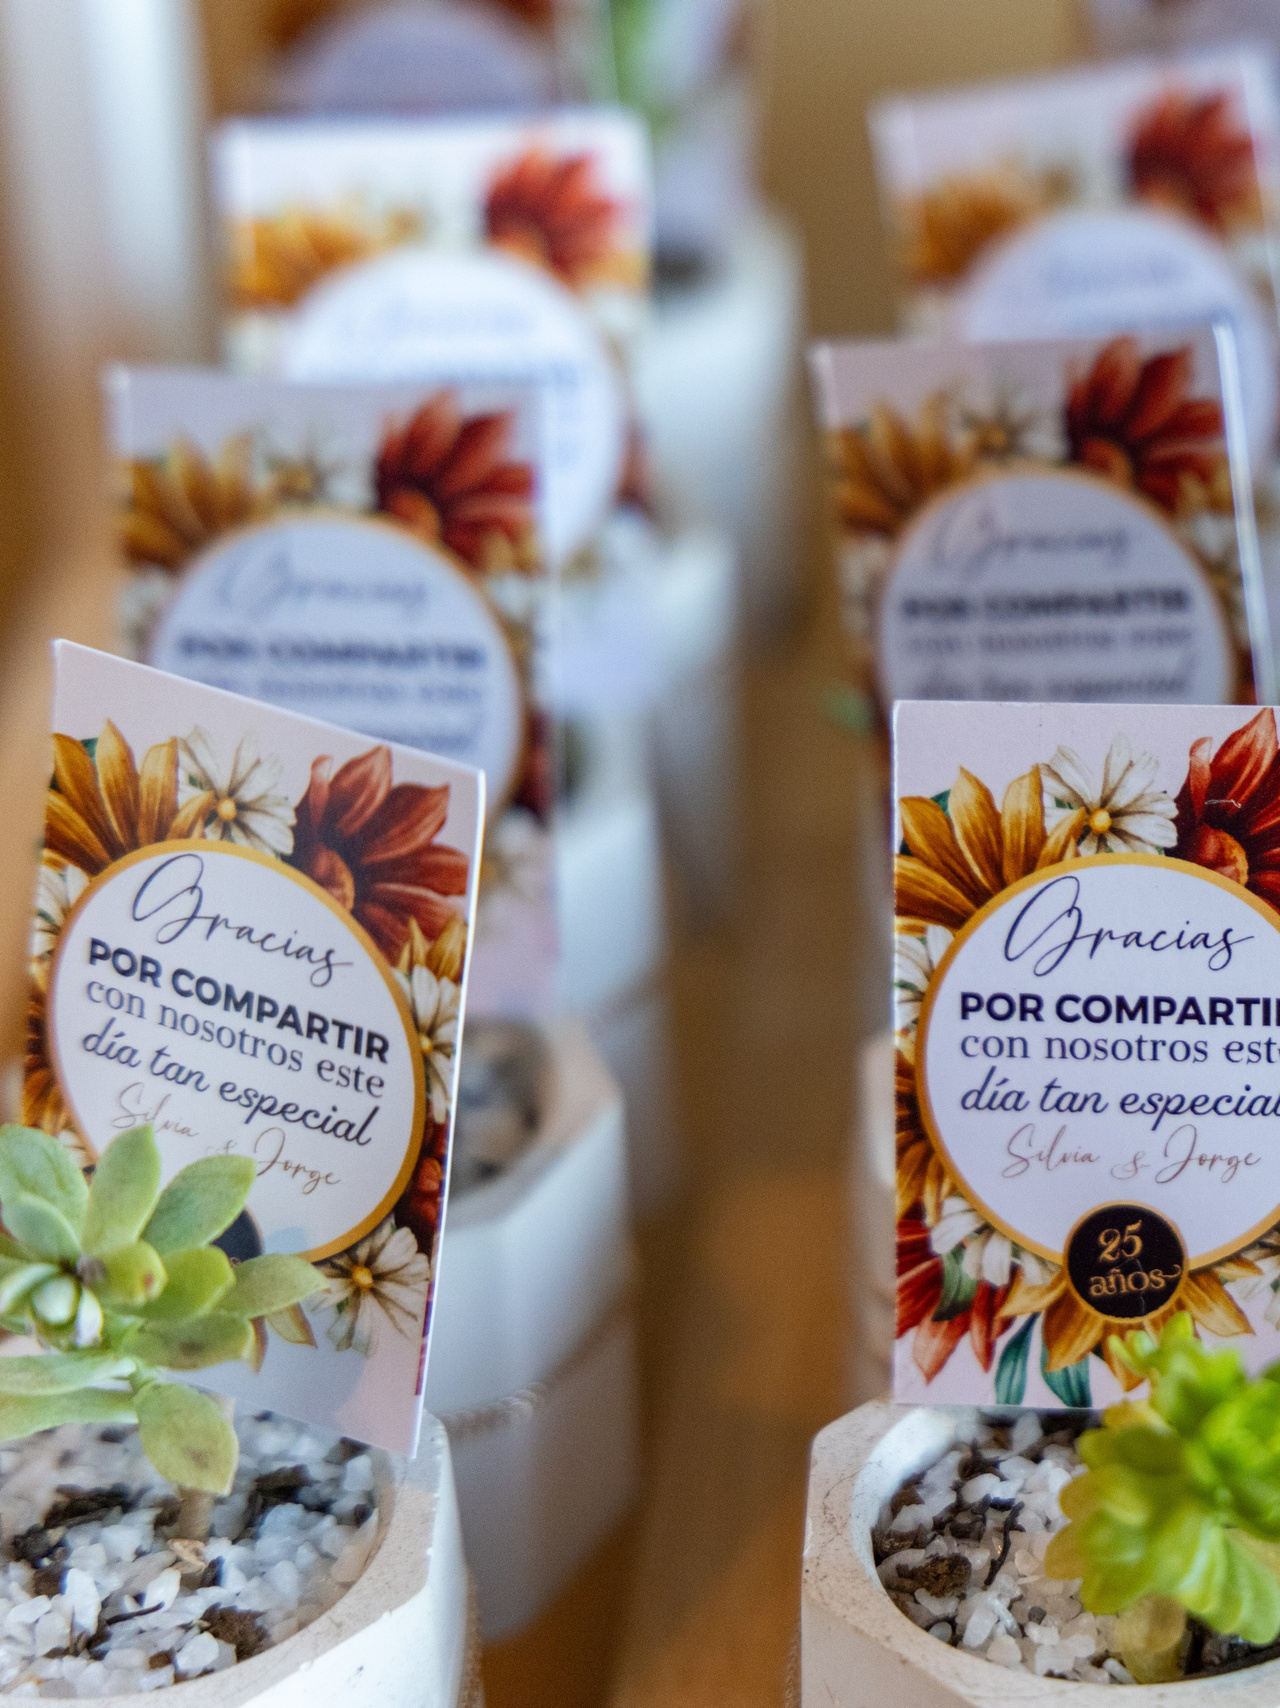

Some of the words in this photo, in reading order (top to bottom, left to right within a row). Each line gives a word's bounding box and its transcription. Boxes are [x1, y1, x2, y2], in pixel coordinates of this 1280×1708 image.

[132, 853, 354, 987] Gracias
[1003, 875, 1255, 977] Gracias
[89, 937, 161, 988] POR
[171, 968, 390, 1064] COMPARTIR
[960, 991, 1045, 1023] POR
[86, 980, 147, 1019] con
[159, 1003, 303, 1073] nosotros
[316, 1058, 386, 1099] este
[960, 1033, 1030, 1059] con
[1044, 1033, 1209, 1063] nosotros
[81, 1017, 142, 1069] día
[150, 1045, 210, 1093] tan
[219, 1080, 381, 1147] especial
[960, 1065, 1029, 1113] día
[1040, 1077, 1107, 1115] tan
[254, 1127, 341, 1195] Jorge
[1002, 1123, 1100, 1178] Silvia
[1155, 1123, 1261, 1184] Jorge
[1099, 1219, 1142, 1261] 25
[1090, 1264, 1181, 1297] años
